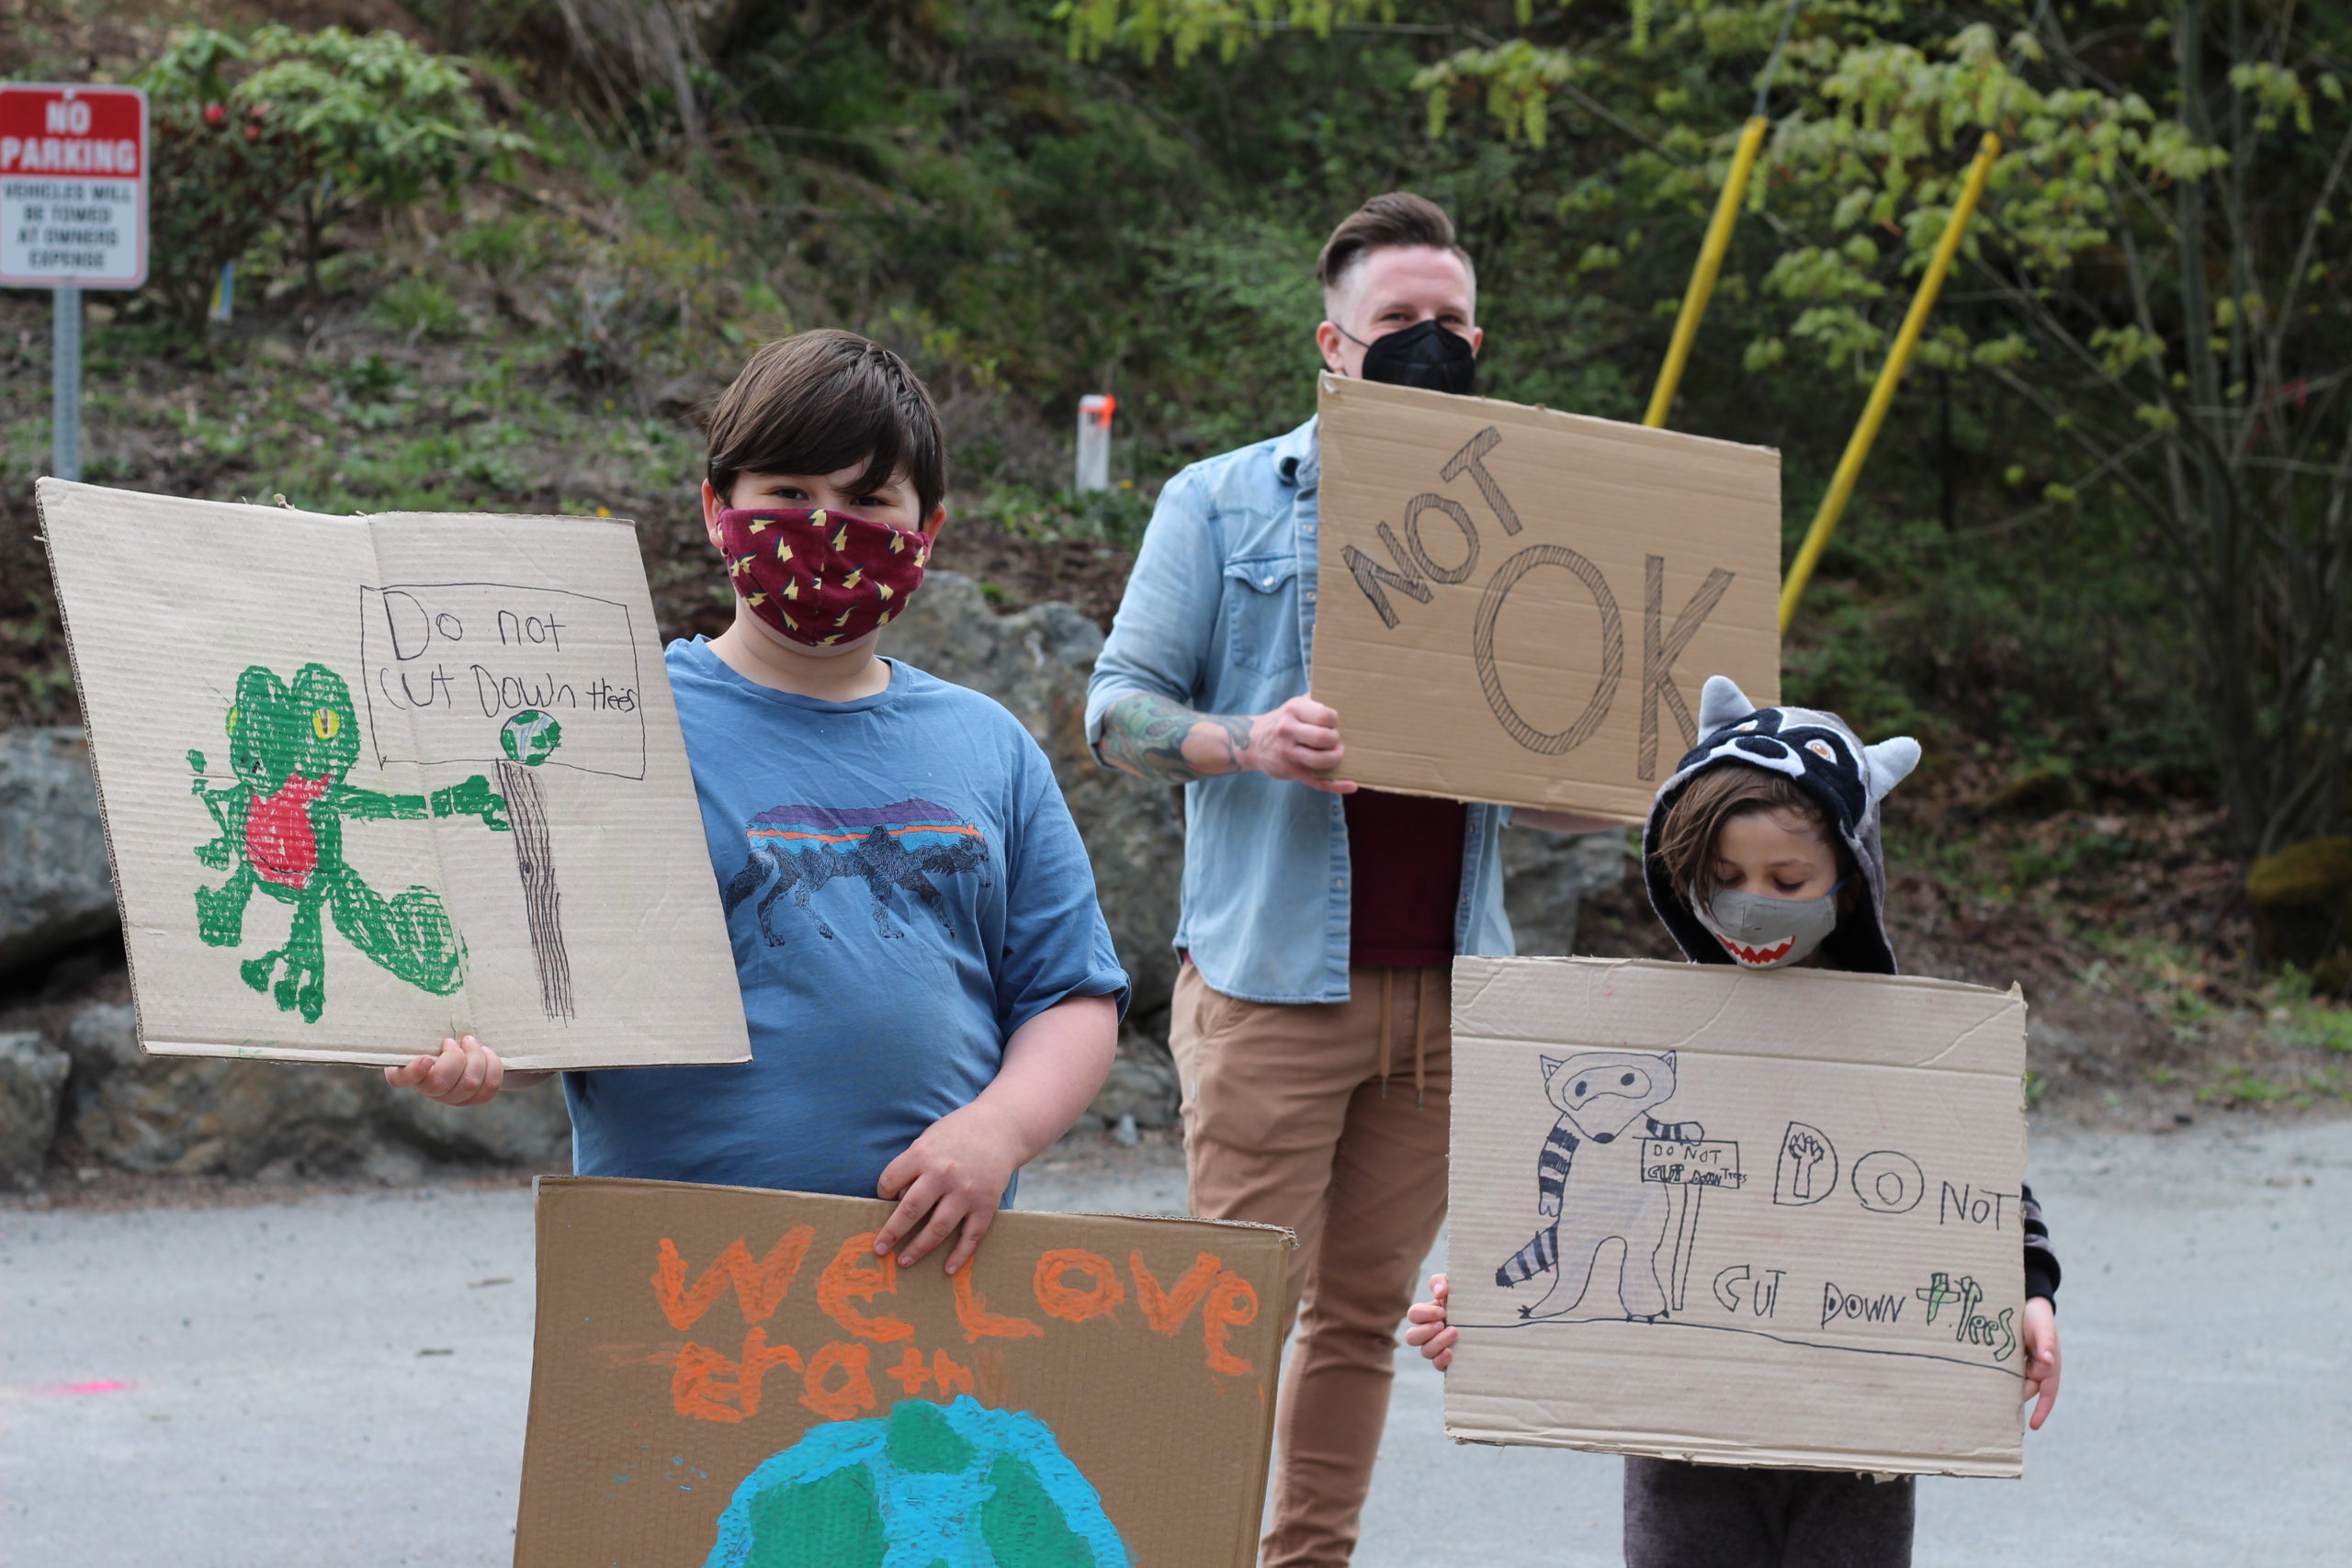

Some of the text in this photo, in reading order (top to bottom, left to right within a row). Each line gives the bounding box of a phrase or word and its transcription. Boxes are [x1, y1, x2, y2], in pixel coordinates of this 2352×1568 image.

[47, 100, 91, 135] NO
[0, 135, 137, 173] PARKING
[4, 185, 131, 203] VEHICLES WILL
[25, 206, 111, 225] BE TOWED
[17, 229, 119, 247] AT OWNERS
[28, 251, 105, 269] EXPENSE
[1340, 425, 1522, 630] NOT
[382, 591, 566, 660] Do not
[1474, 544, 1736, 781] OK
[470, 663, 576, 717] Down
[1653, 1145, 1722, 1165] DO NOT
[1773, 1121, 2019, 1231] DO NOT
[1713, 1264, 1787, 1318] CUT
[1821, 1281, 1906, 1330] DOWN
